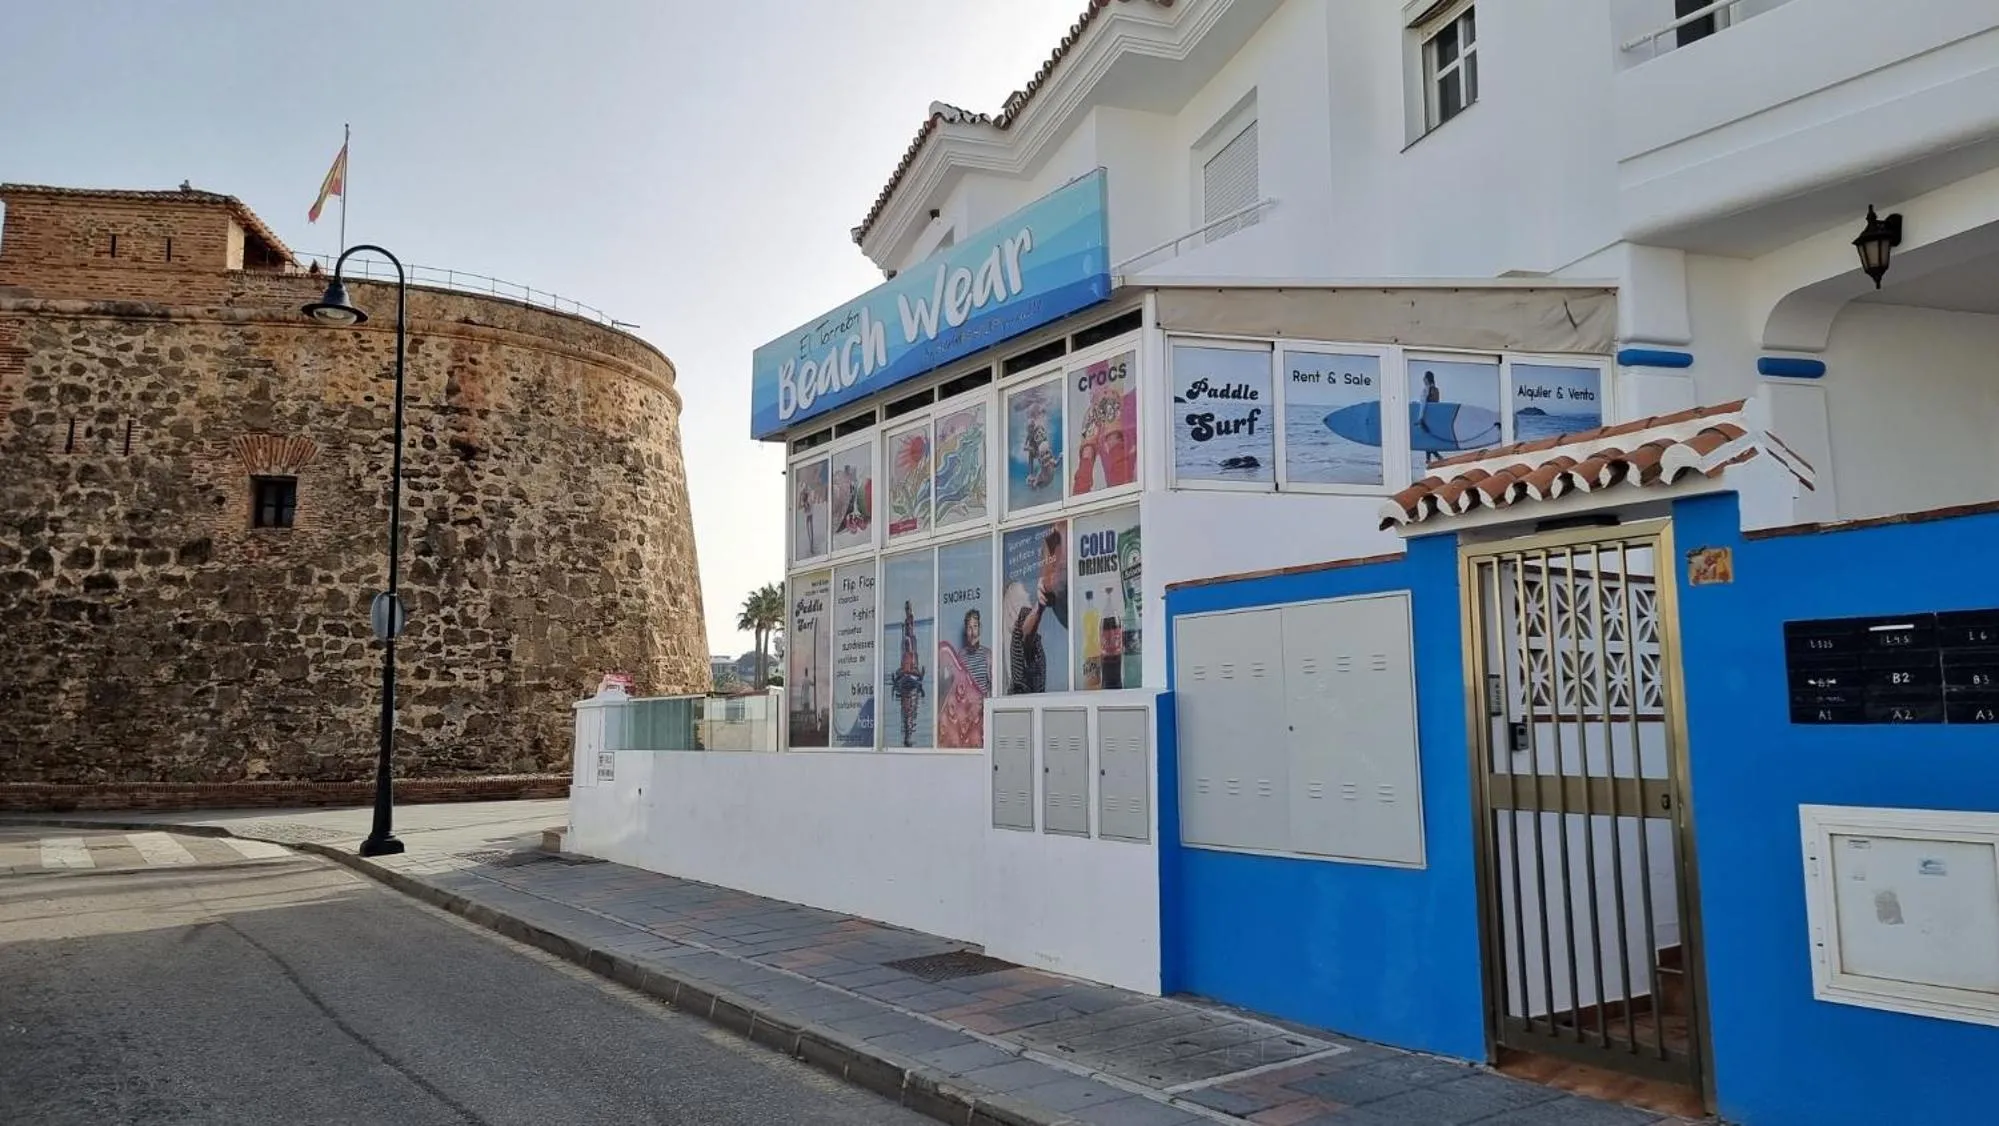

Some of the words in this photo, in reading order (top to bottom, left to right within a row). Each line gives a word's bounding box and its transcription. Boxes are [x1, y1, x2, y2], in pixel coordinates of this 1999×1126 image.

[779, 305, 887, 420] Beach
[898, 226, 1032, 344] Wear
[800, 334, 811, 361] El
[816, 310, 860, 346] Torreón
[1078, 363, 1127, 392] crocs
[1293, 370, 1320, 383] Rent
[1327, 371, 1336, 384] &
[1344, 373, 1371, 386] Sale
[1186, 378, 1259, 400] Paddle
[1518, 385, 1552, 401] Alquiler
[1556, 386, 1563, 399] &
[1568, 387, 1595, 401] Venta
[1185, 408, 1261, 442] Surf
[1080, 530, 1115, 558] COLD
[1078, 555, 1119, 576] DRINKS
[843, 578, 856, 593] Flip
[943, 587, 981, 604] SNORKELS
[795, 598, 823, 617] Paddle
